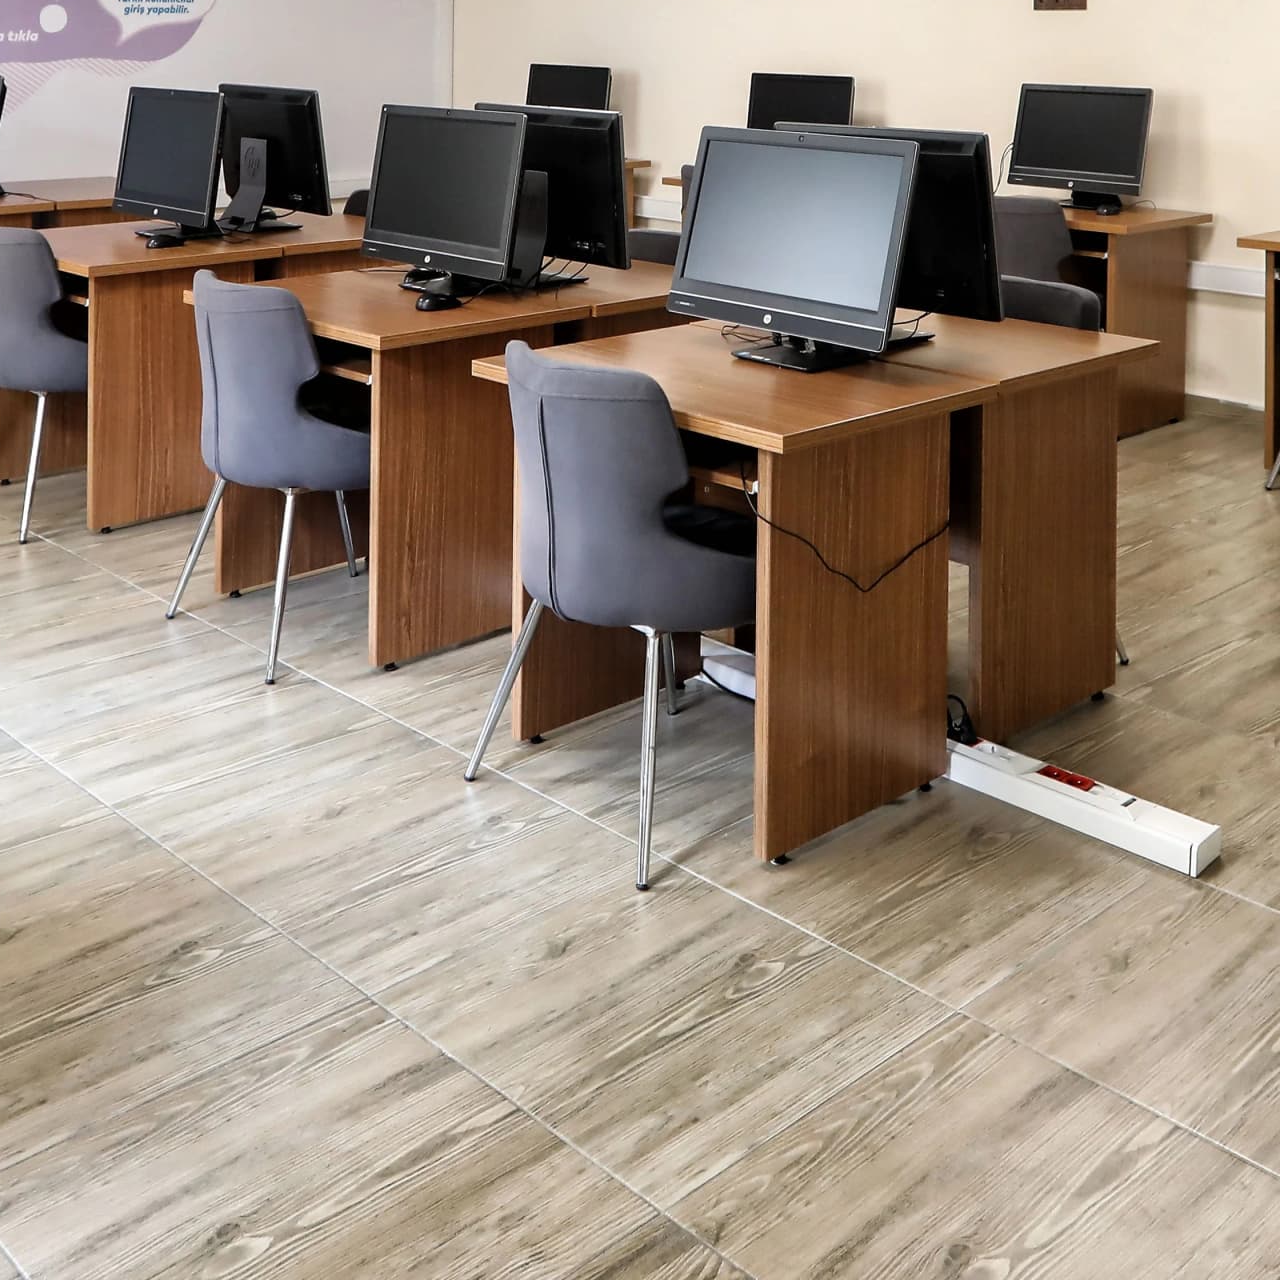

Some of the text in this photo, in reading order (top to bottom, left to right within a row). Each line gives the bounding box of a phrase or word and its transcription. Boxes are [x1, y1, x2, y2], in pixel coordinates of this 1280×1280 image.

[124, 5, 190, 15] giriş yapabilir.
[7, 29, 40, 42] tıkla
